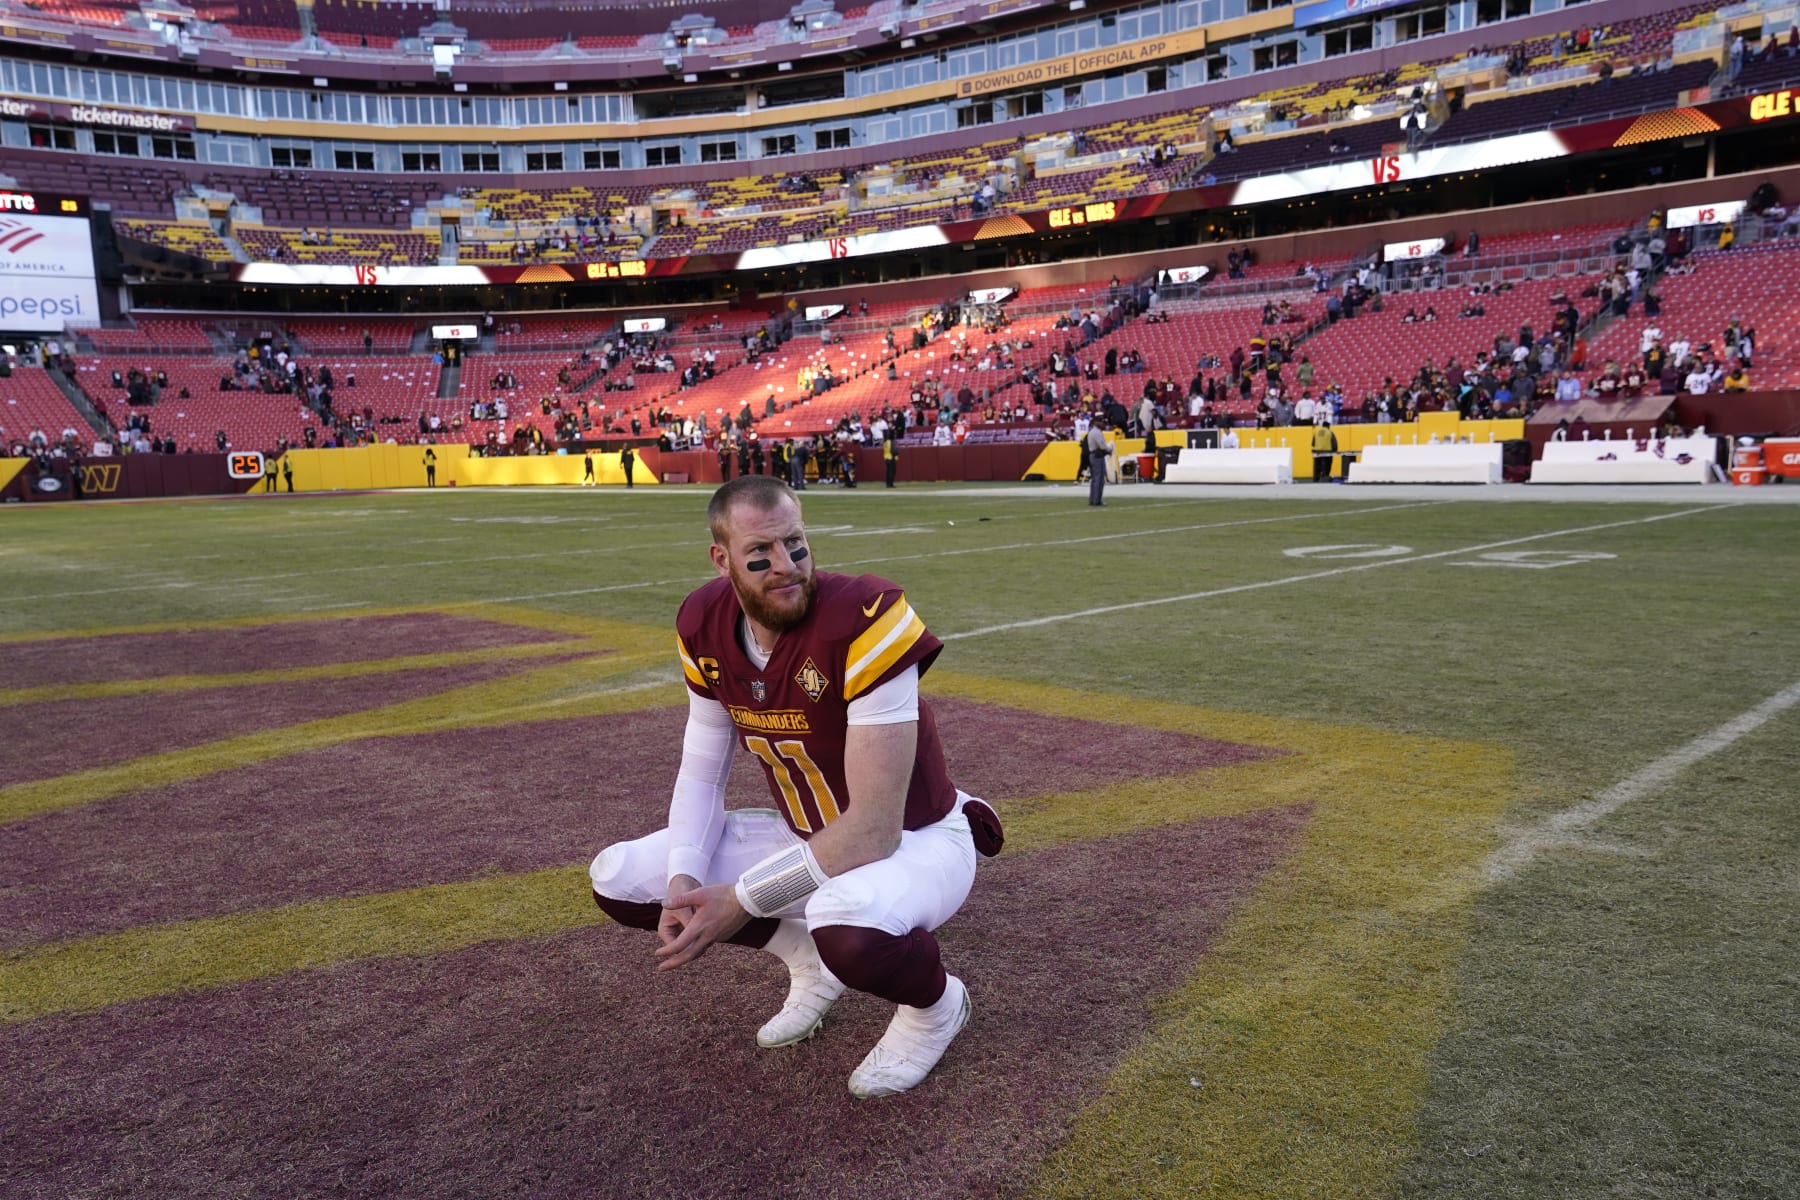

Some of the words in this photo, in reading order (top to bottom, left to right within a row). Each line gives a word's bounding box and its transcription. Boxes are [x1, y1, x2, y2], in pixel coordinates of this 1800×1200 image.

[974, 68, 1042, 92] DOWNLOAD
[1046, 62, 1070, 80] THE
[1079, 48, 1136, 71] OFFICIAL
[1139, 41, 1167, 58] APP
[1750, 91, 1791, 120] CLE
[70, 106, 176, 131] ticketmaster
[1372, 156, 1400, 184] VS
[1049, 208, 1071, 227] CLE
[1699, 208, 1715, 221] VS
[829, 237, 847, 258] VS
[1408, 244, 1421, 256] VS
[15, 262, 65, 272] AMERICA
[355, 264, 377, 285] VS
[0, 294, 81, 319] pepsi
[234, 455, 258, 474] 25
[1739, 472, 1751, 484] G
[698, 656, 720, 680] C
[729, 708, 810, 731] COMMANDERS
[745, 735, 840, 833] 11
